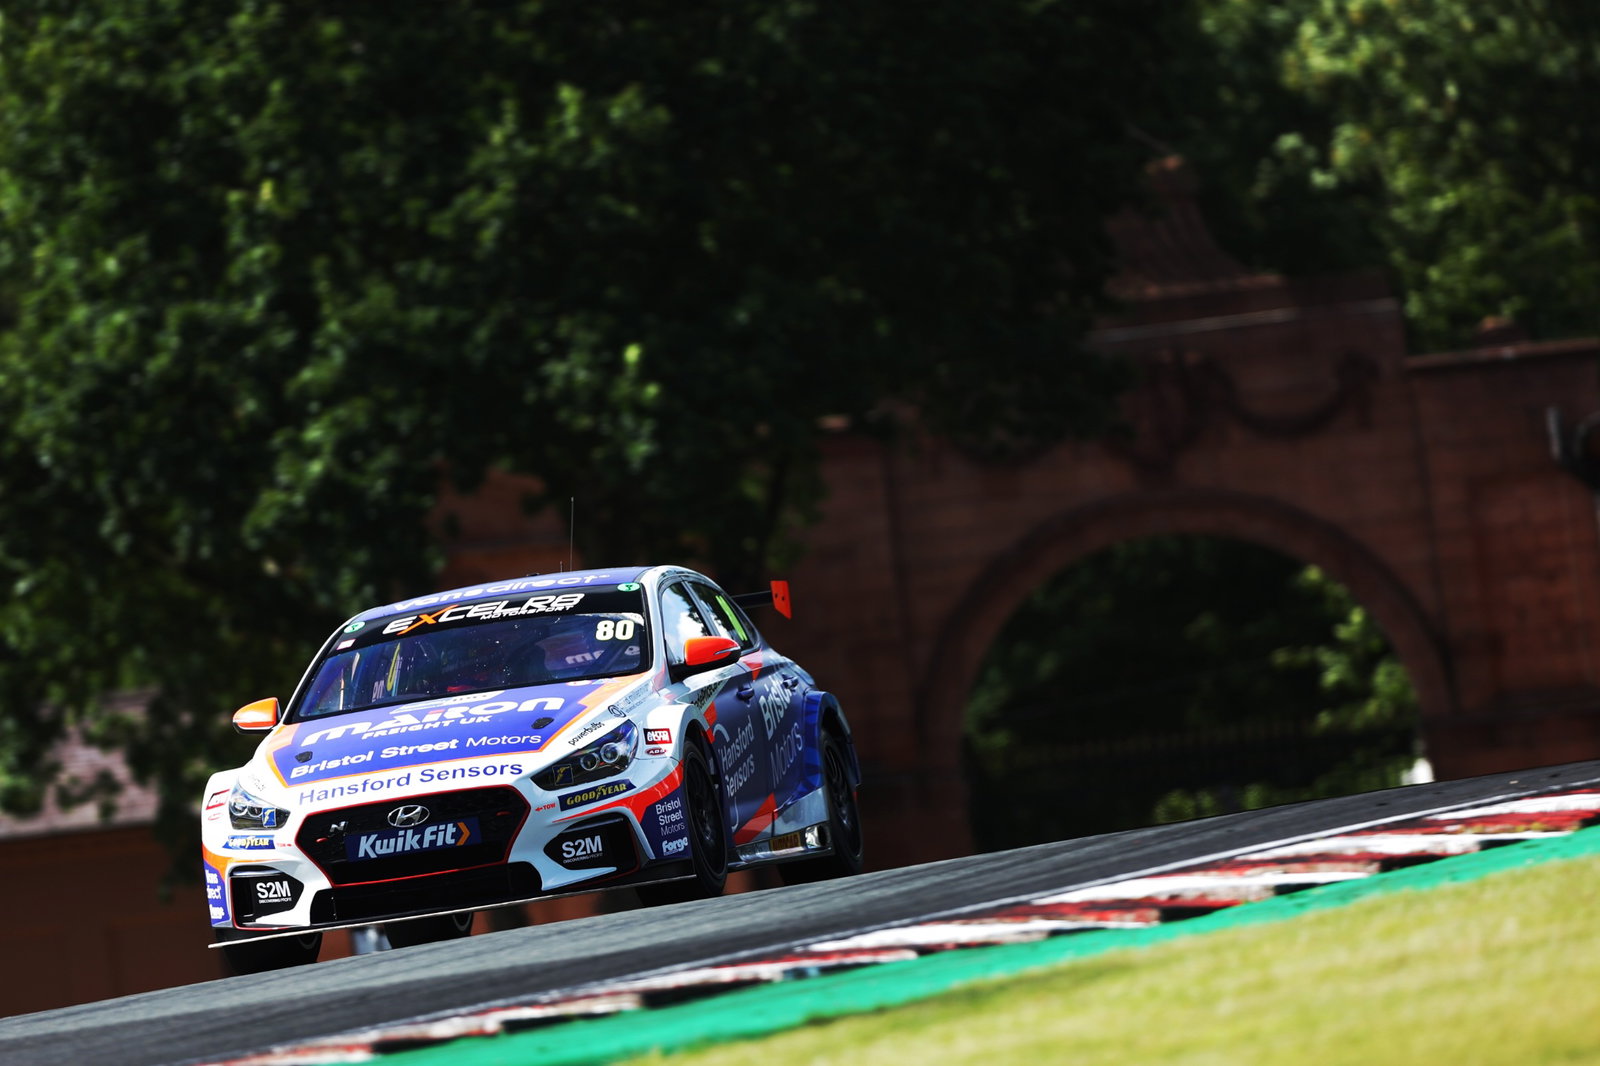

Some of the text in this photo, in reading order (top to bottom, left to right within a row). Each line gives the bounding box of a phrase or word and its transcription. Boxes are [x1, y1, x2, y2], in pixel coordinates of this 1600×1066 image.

[480, 605, 575, 620] MOTORSPORT
[595, 620, 635, 641] 80
[759, 675, 793, 740] Bristo
[361, 715, 493, 740] FREIGHT UK
[720, 715, 754, 773] Hansford
[770, 722, 803, 789] Motors
[289, 734, 542, 779] Bristol Street Motors
[299, 773, 411, 805] Hansford
[419, 762, 523, 783] Sensors
[655, 797, 682, 815] Bristol
[658, 810, 684, 826] Street
[660, 822, 686, 836] Motors
[562, 835, 603, 858] S2M
[256, 881, 291, 898] S2M
